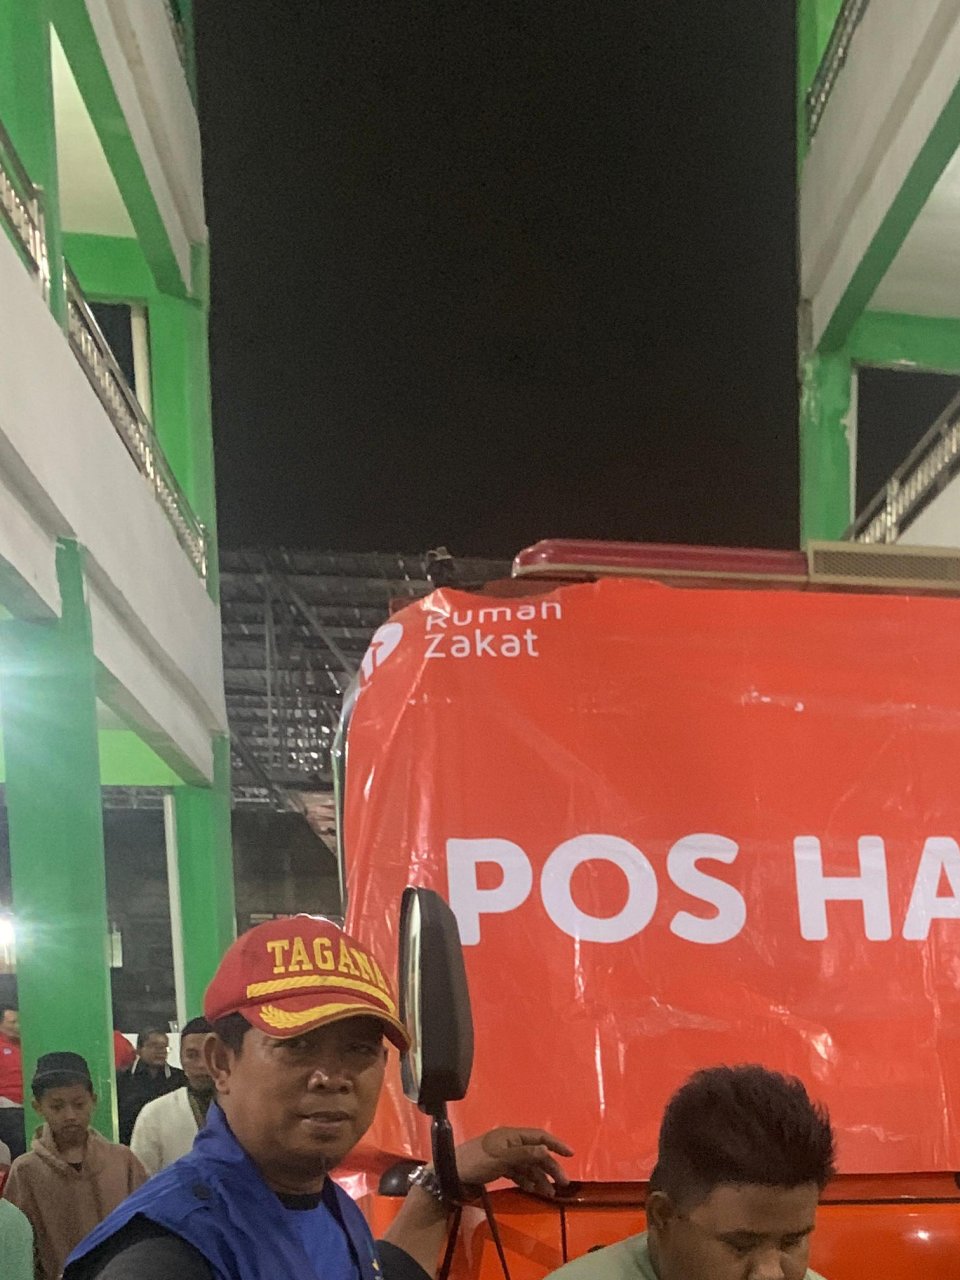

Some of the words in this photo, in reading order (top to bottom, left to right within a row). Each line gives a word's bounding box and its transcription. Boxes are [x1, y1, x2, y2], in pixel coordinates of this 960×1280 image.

[426, 601, 562, 631] Rumah
[424, 628, 540, 658] Zakat
[446, 833, 747, 946] POS
